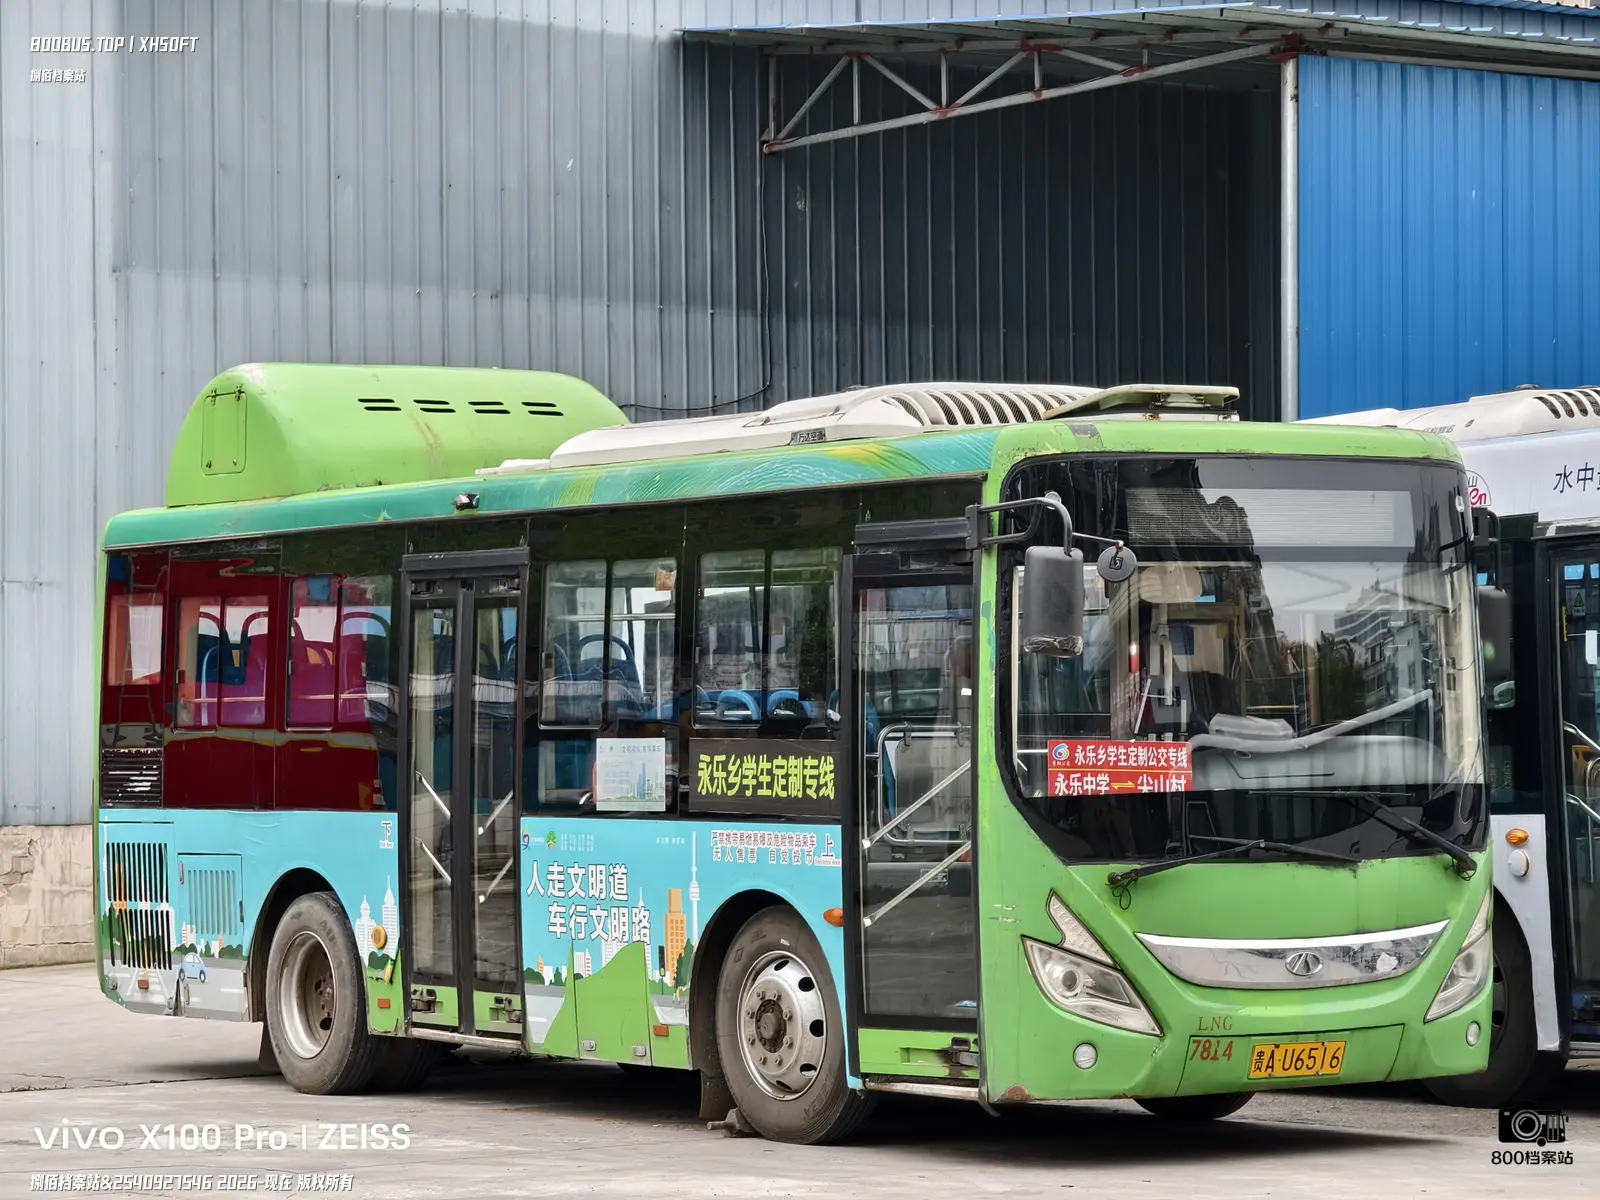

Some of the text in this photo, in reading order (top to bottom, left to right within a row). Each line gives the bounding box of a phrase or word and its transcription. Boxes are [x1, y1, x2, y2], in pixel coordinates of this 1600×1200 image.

[1553, 462, 1600, 494] 水中
[1074, 744, 1188, 768] 永乐乡学生定制公交专线
[697, 754, 835, 800] 永乐乡学生定制专线
[1054, 773, 1110, 796] 永乐中学
[820, 833, 835, 857] 上
[526, 860, 628, 901] 人走文明道
[548, 901, 651, 945] 车行文明路
[1197, 1016, 1233, 1031] LNG
[1188, 1039, 1234, 1062] 7814
